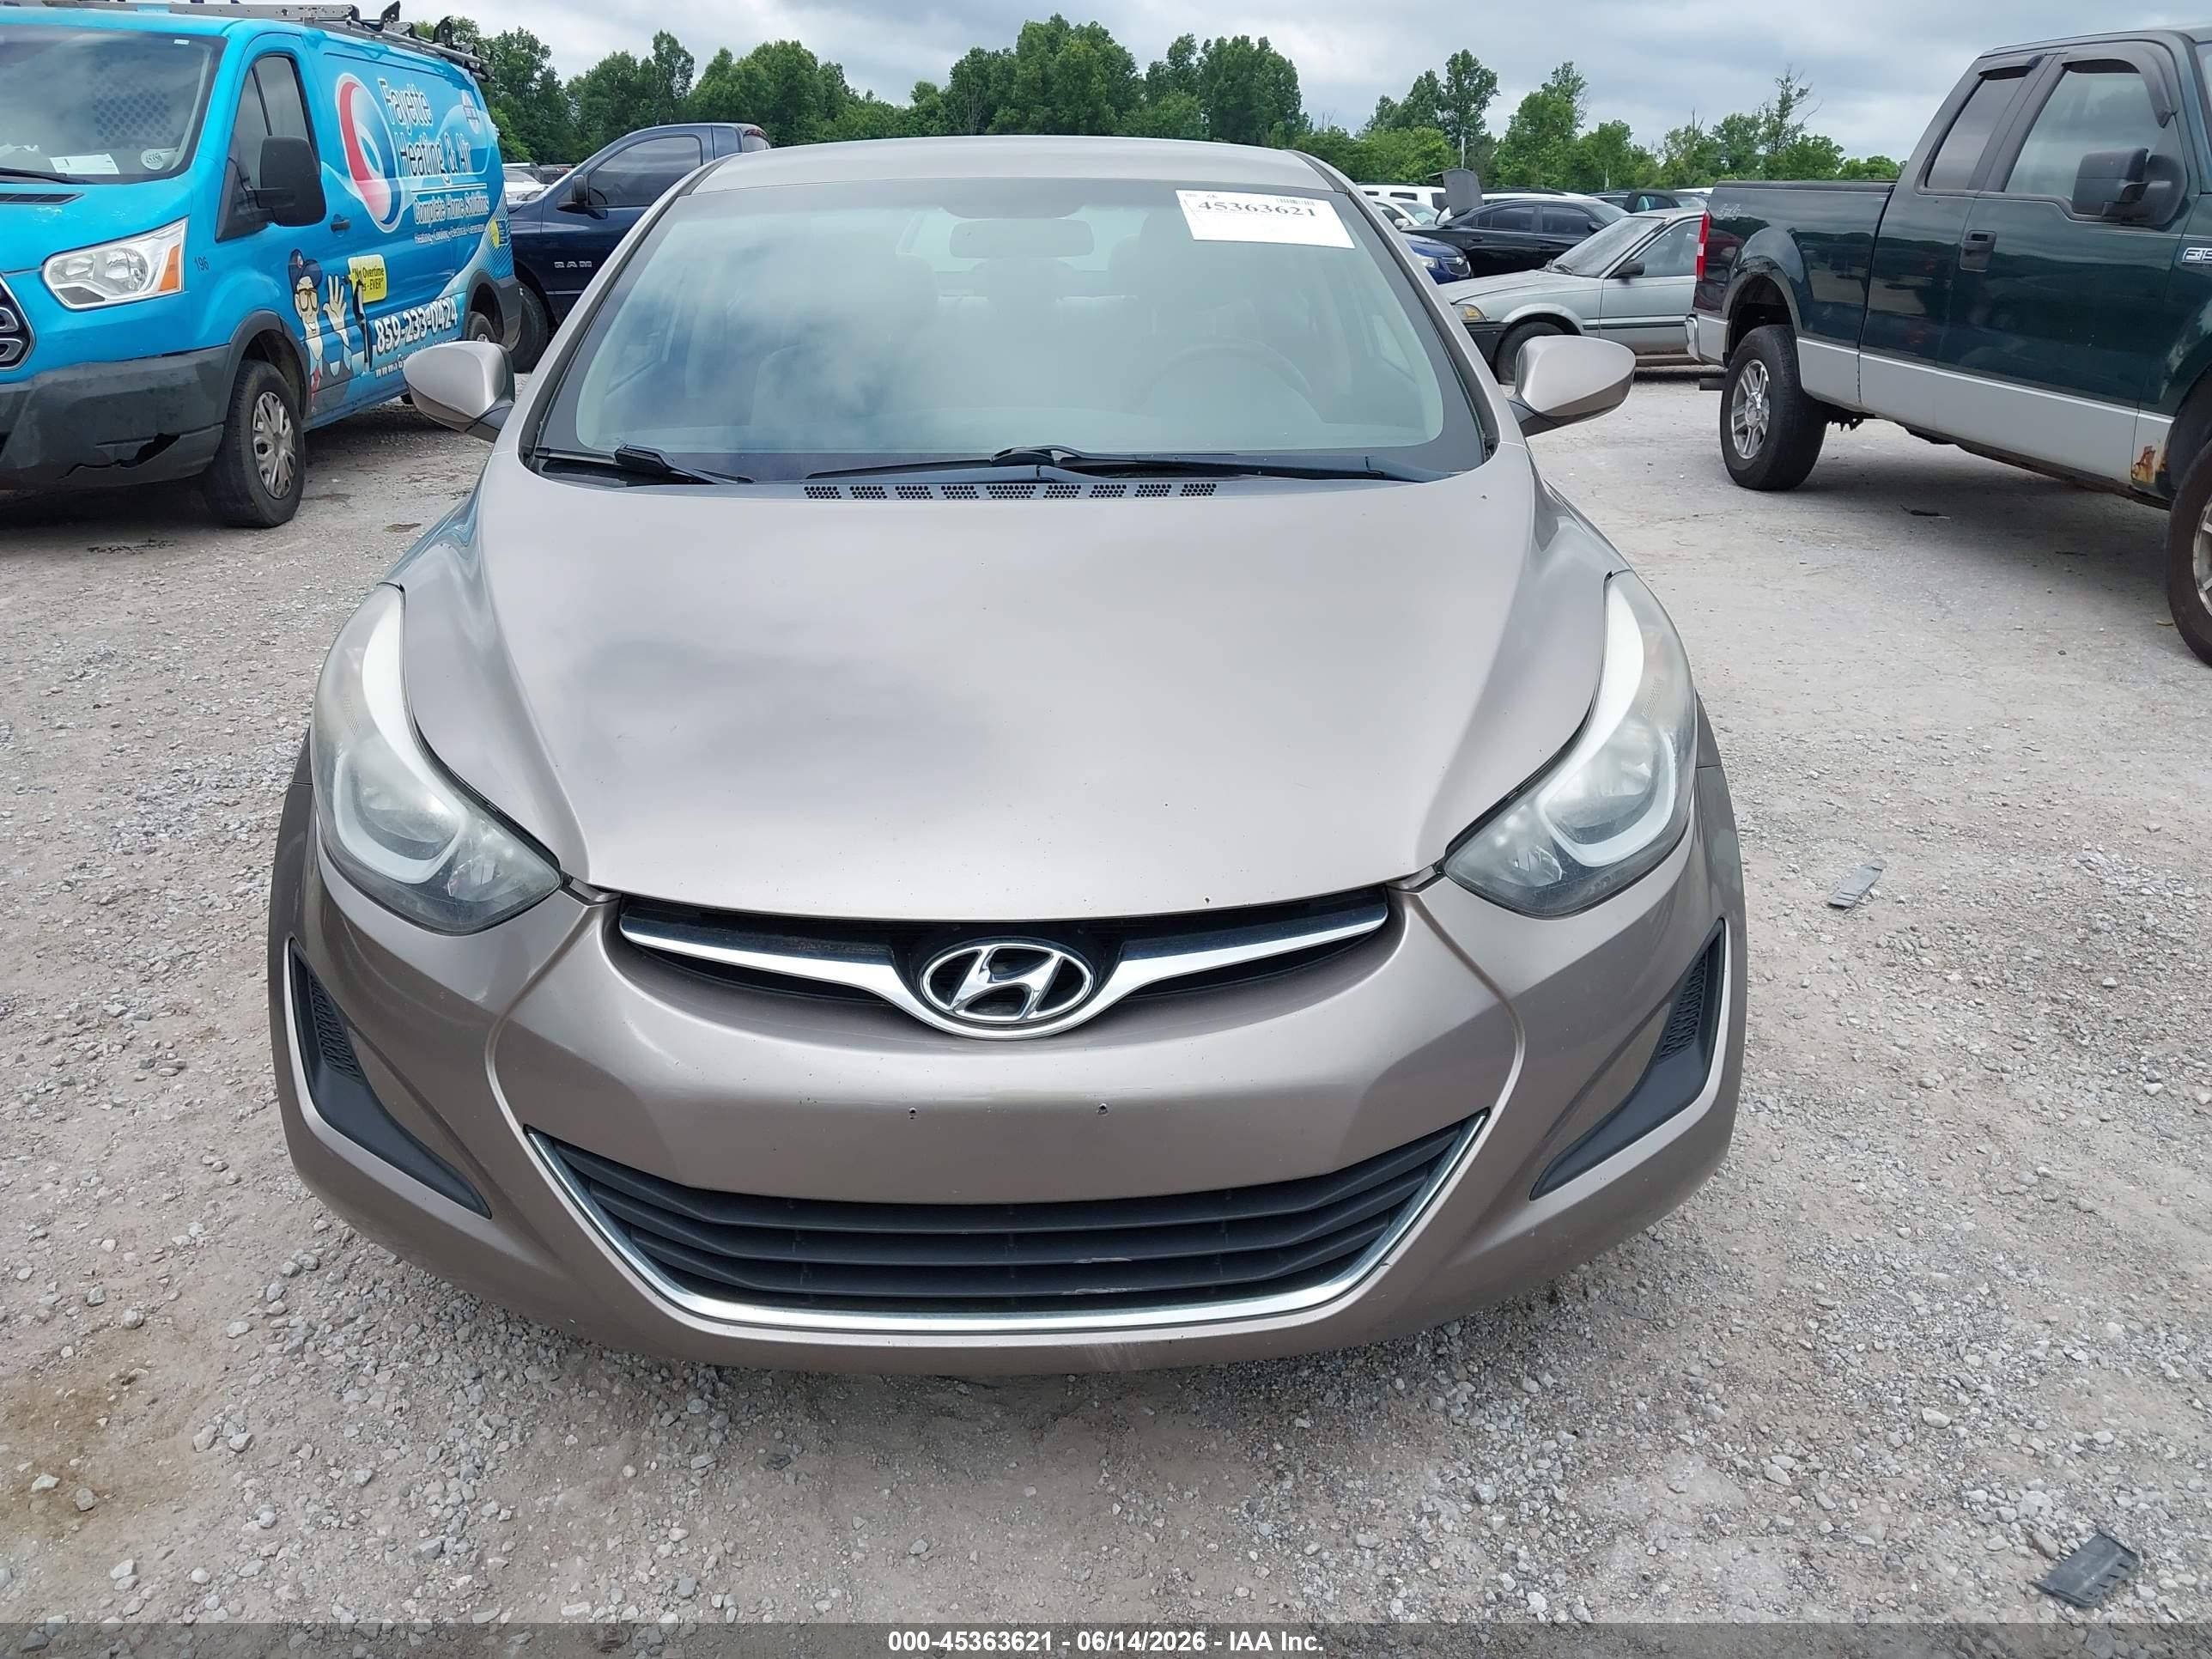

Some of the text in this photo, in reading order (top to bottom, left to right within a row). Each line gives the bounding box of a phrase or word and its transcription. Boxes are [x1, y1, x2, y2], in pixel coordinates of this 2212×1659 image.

[378, 78, 433, 136] Fayette
[394, 132, 472, 184] Heating & Air
[414, 191, 489, 228] Complete Home Solutions
[1198, 201, 1316, 217] 45363621
[194, 256, 210, 272] 196
[362, 265, 384, 278] Overtime
[374, 297, 458, 353] 859-233-0424
